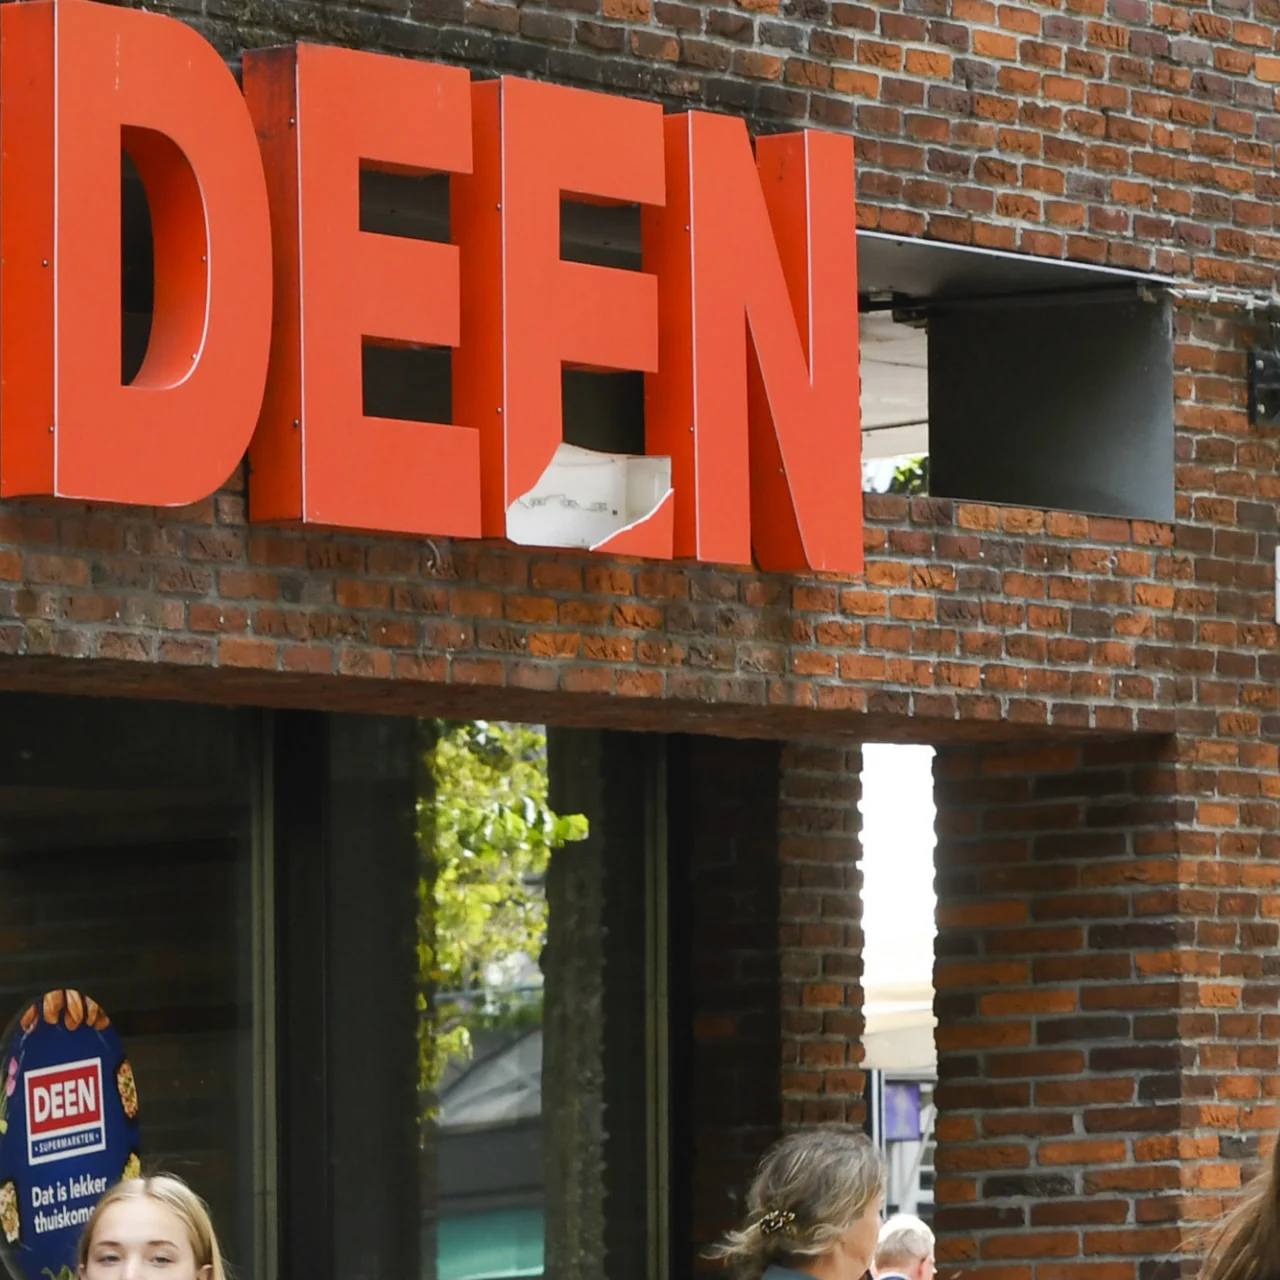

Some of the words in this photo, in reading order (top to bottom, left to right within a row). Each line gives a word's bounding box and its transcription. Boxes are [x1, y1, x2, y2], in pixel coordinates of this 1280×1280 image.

[0, 0, 863, 574] DEEN
[33, 1076, 96, 1123] DEEN
[39, 1132, 95, 1154] SUPERMARKTEN
[32, 1186, 55, 1208] Dat
[57, 1181, 67, 1202] is
[70, 1173, 107, 1199] lekker
